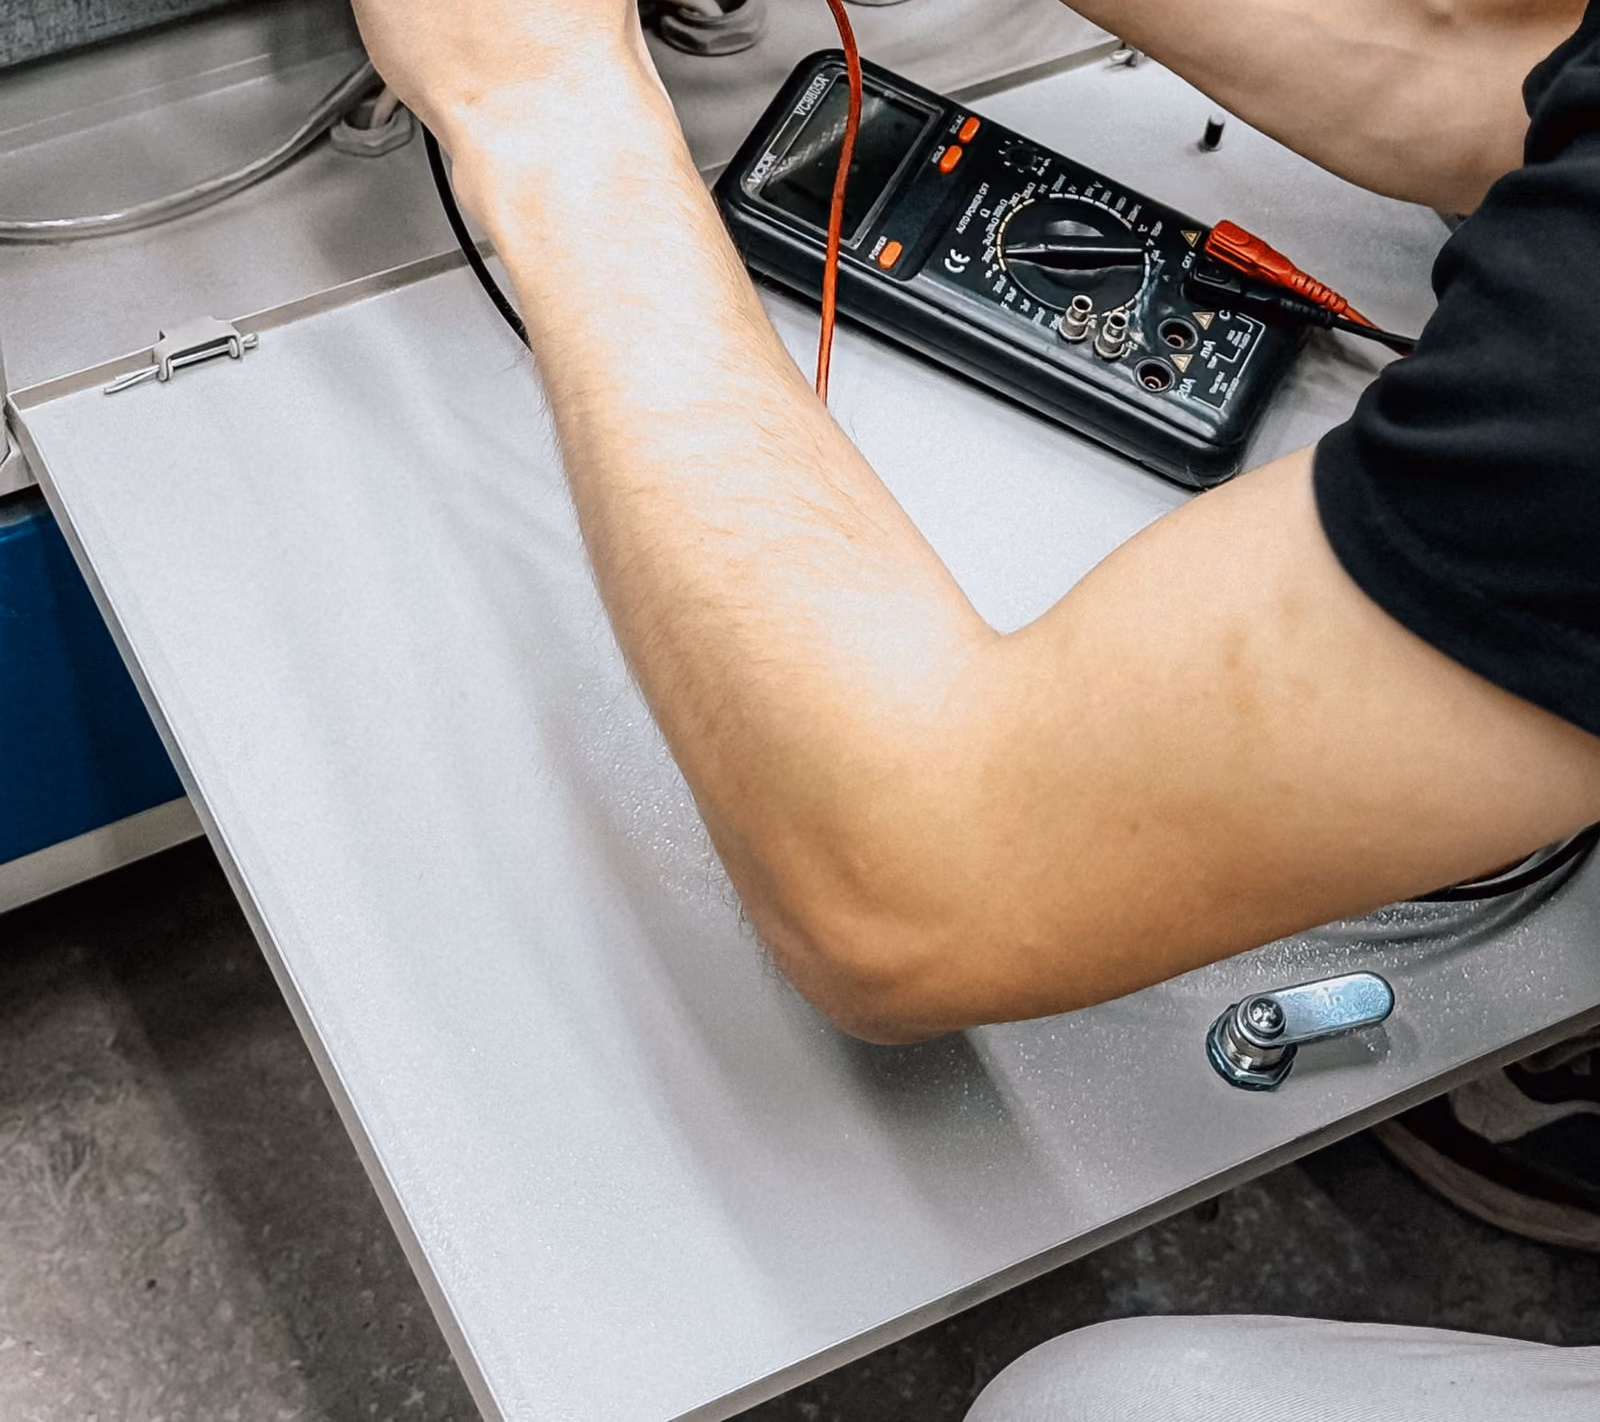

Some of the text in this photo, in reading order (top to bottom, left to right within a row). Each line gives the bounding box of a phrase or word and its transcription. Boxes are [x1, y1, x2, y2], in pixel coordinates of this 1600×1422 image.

[956, 181, 991, 235] AUTO POWER OFF
[868, 235, 888, 261] POWER
[1200, 340, 1217, 359] mA
[1176, 377, 1197, 402] 20A
